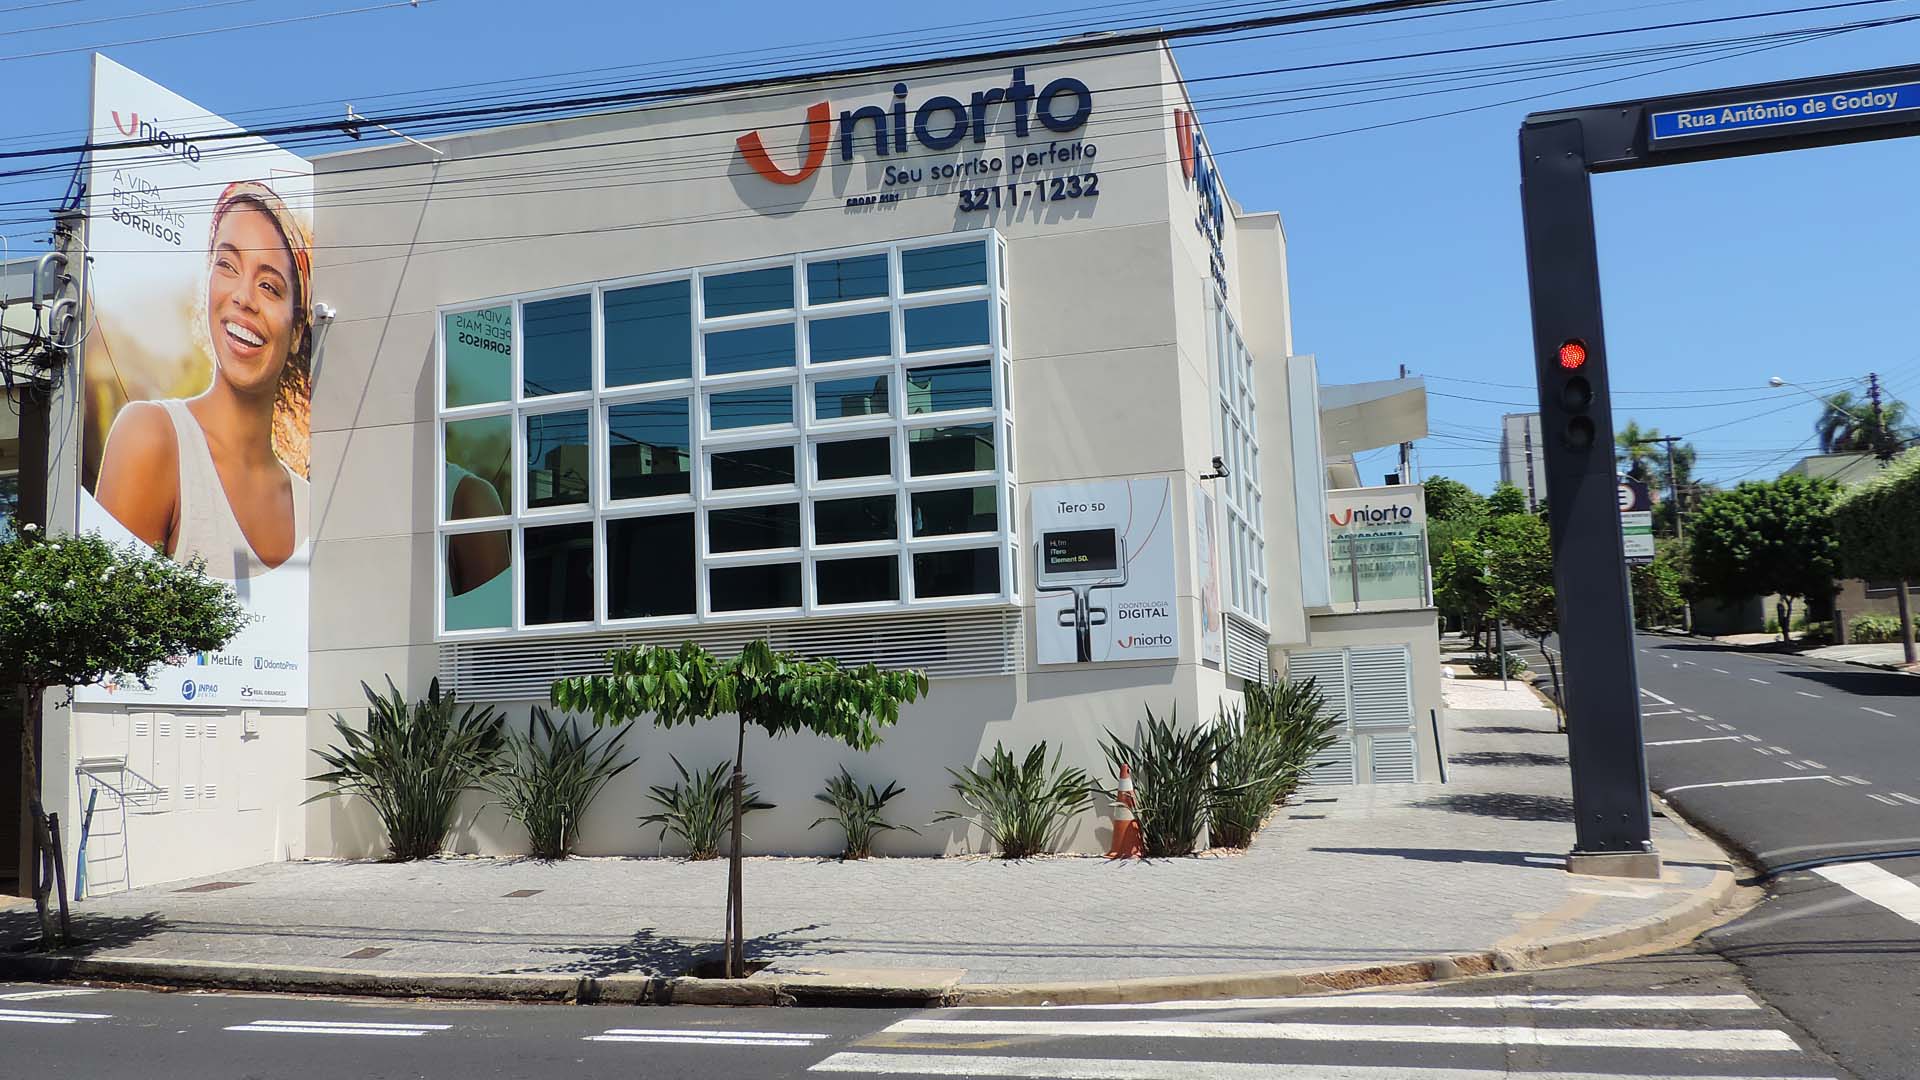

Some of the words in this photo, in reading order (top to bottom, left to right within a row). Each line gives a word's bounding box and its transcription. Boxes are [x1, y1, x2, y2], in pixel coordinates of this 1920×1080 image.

[736, 66, 1092, 185] Uniorto
[1677, 113, 1716, 129] Rua
[1720, 102, 1797, 124] Antônio
[1802, 98, 1827, 114] de
[1832, 91, 1898, 112] Godoy
[112, 110, 200, 163] Uniorto
[885, 165, 922, 186] Seu
[931, 156, 1002, 181] sorriso
[1011, 141, 1097, 174] perfeito
[113, 168, 124, 185] A
[128, 172, 160, 200] VIDA
[960, 173, 1099, 212] 3211-1232
[112, 207, 181, 246] SORRISOS
[113, 187, 149, 214] PEDE
[153, 203, 185, 229] MAIS
[1057, 501, 1088, 514] iTero
[1091, 502, 1106, 512] 5D
[1329, 504, 1412, 526] Uniorto
[1119, 607, 1169, 619] DIGITAL
[1117, 633, 1172, 648] Uniorto
[211, 654, 243, 666] MetLife
